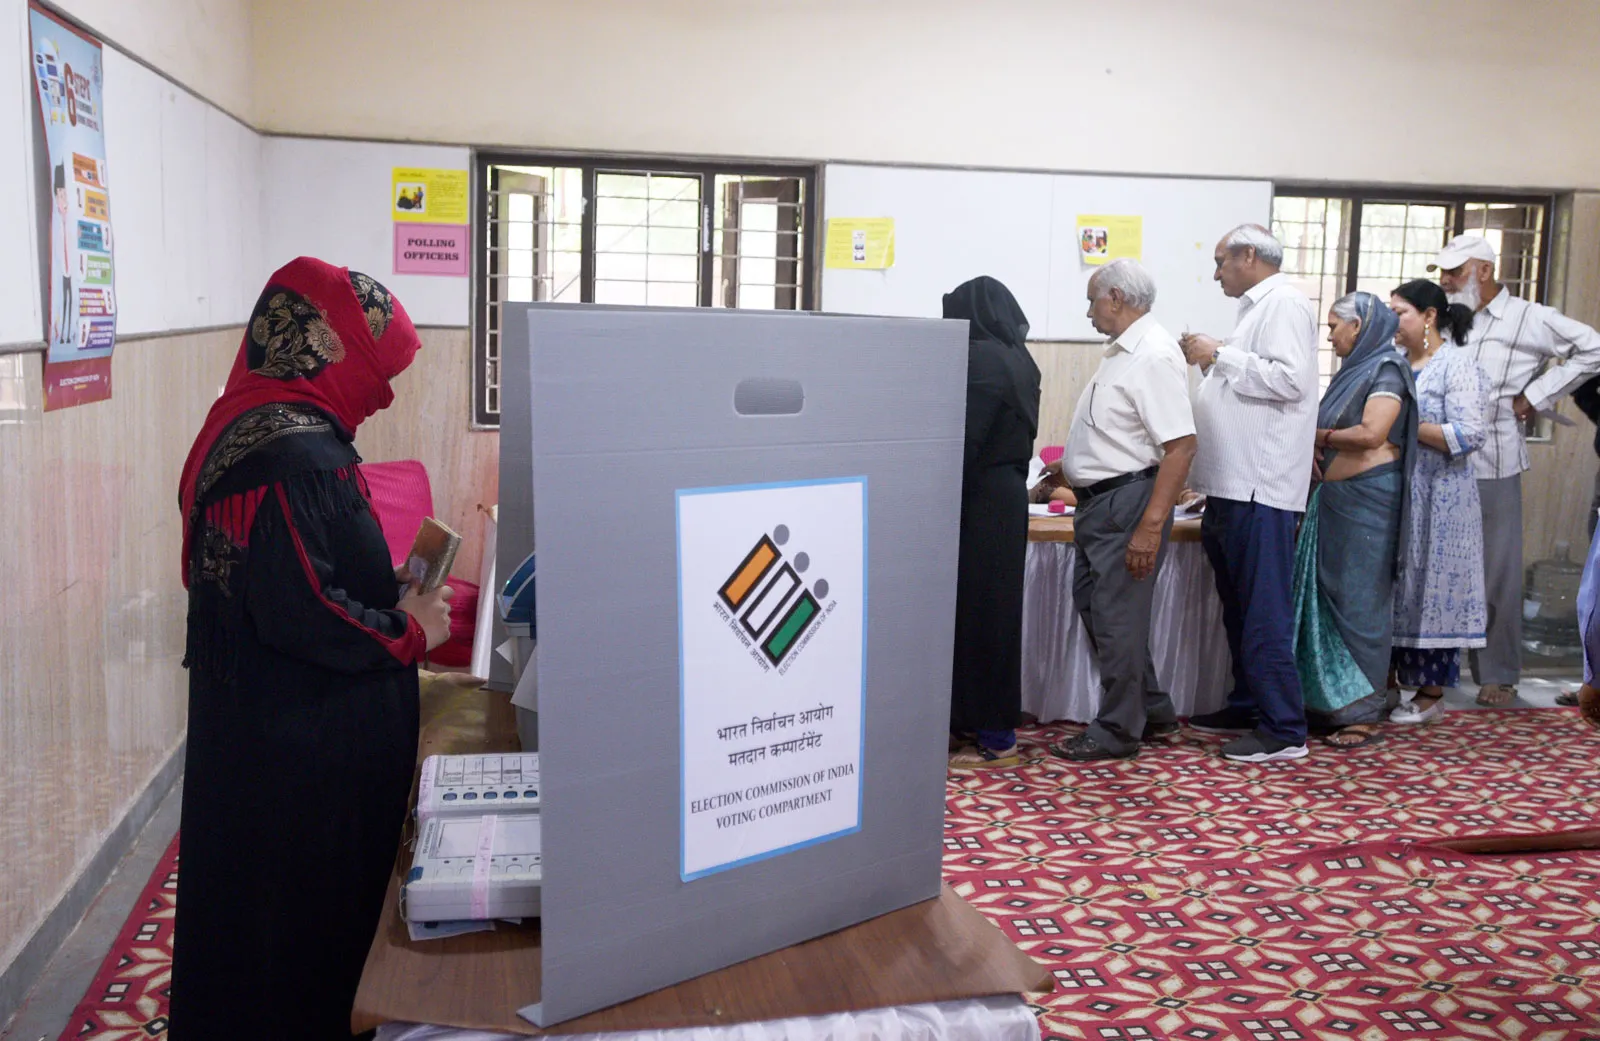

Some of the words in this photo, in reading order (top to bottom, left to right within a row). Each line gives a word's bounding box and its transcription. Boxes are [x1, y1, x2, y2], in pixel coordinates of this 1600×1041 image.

[403, 251, 460, 261] OFFICERS
[408, 238, 455, 247] POLLING
[712, 601, 731, 623] भारत
[778, 648, 800, 676] ELECTION
[796, 619, 823, 655] COMMISSION
[825, 600, 838, 617] INDIA
[717, 723, 748, 741] भारत
[751, 712, 795, 736] निर्वाचन
[798, 702, 834, 725] आयोग
[728, 747, 766, 767] मतदान
[769, 731, 823, 758] कम्पार्टमेंट
[691, 790, 743, 814] ELECTION
[745, 773, 811, 801] COMMISSION
[812, 771, 826, 784] OF
[827, 763, 855, 781] INDIA
[716, 809, 757, 830] VOTING
[758, 789, 833, 819] COMPARTMENT
